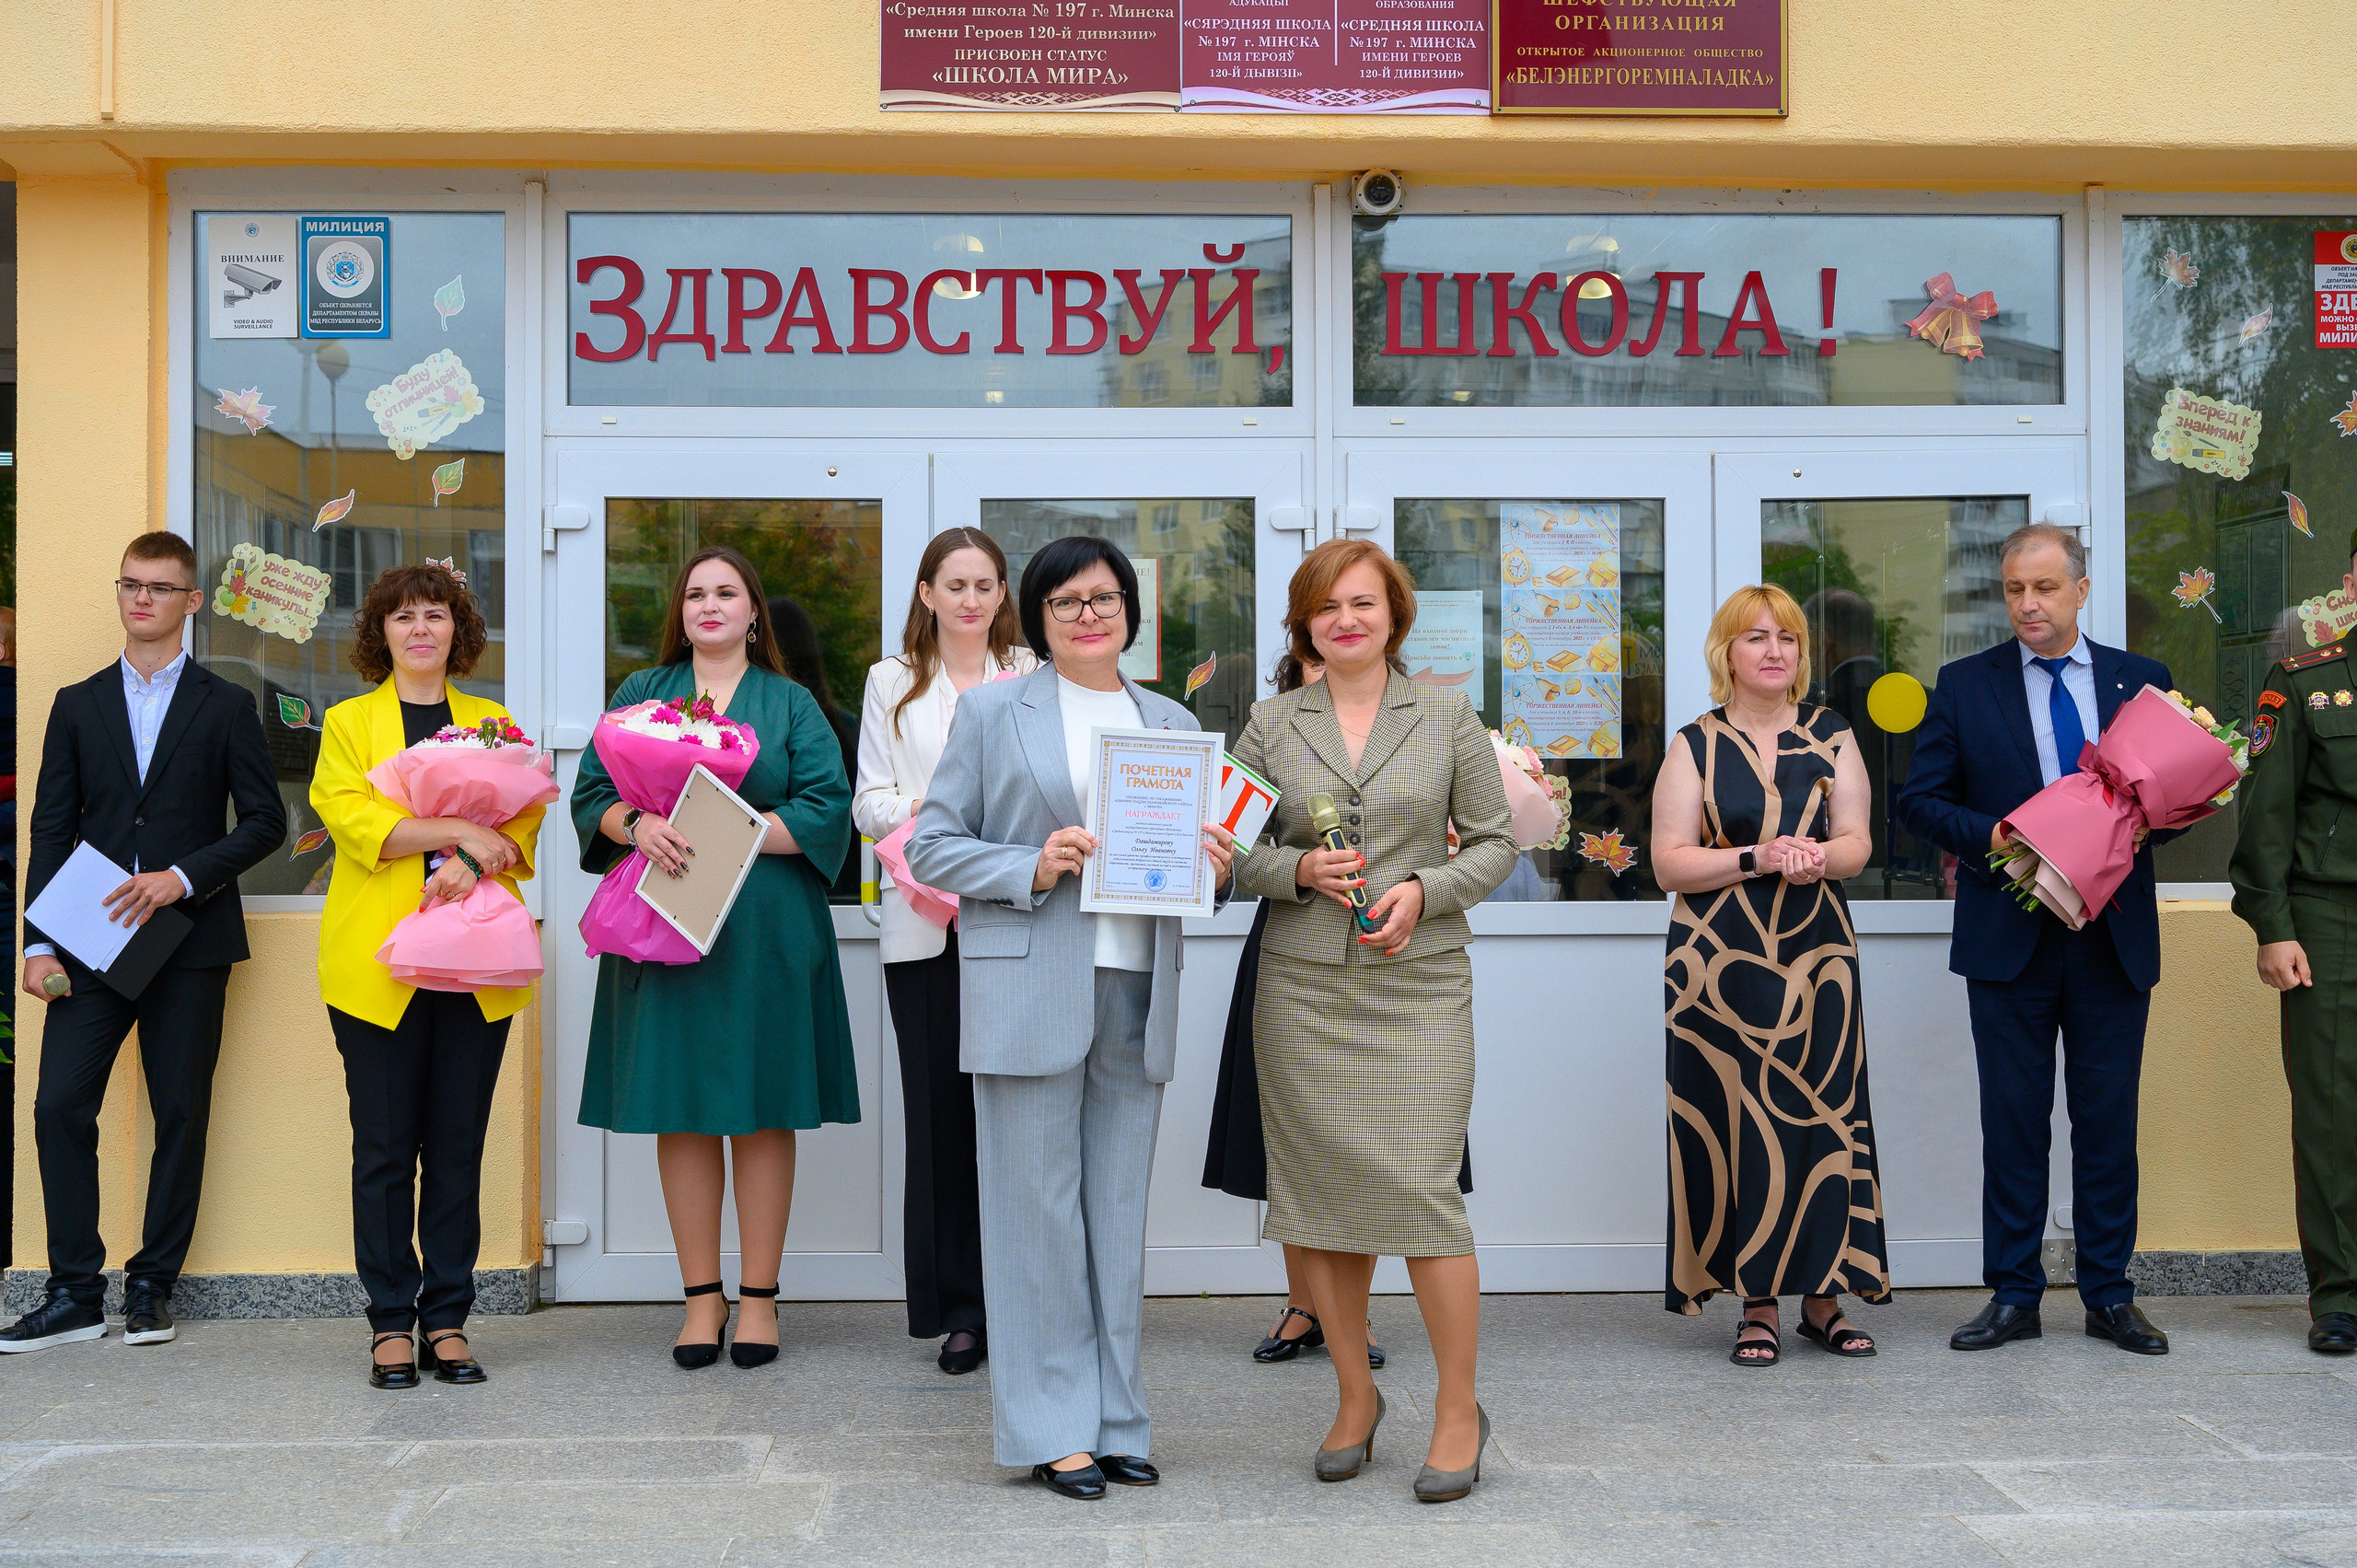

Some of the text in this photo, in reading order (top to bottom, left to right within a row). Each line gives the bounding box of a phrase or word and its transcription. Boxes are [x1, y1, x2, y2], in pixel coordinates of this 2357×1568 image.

[886, 2, 1174, 18] «Средняя школа № 197 г. Минска
[1376, 0, 1454, 9] ОБРАЗОВАНИЯ
[1183, 18, 1332, 32] «СЯРЭДНЯЯ ШКОЛА
[1341, 20, 1485, 32] «СРЕДНЯЯ ШКОЛА
[1555, 15, 1725, 33] ОРГАНИЗАЦИЯ
[904, 25, 1157, 41] имени Героев 120-й дивизии»
[1244, 39, 1254, 48] г.
[1259, 36, 1320, 48] МІНСКА
[1396, 39, 1406, 48] г.
[1410, 37, 1477, 48] МИНСКА
[955, 49, 1107, 62] ПРИСВОЕН СТАТУС
[1216, 50, 1295, 62] ІМЯ ГЕРОЯЎ
[1362, 52, 1462, 62] ИМЕНИ ГЕРОЕВ
[1516, 46, 1763, 58] ОТКРЫТОЕ АКЦИОНЕРНОЕ ОБЩЕСТВО
[932, 66, 1128, 85] «ШКОЛА МИРА»
[1210, 65, 1240, 78] 120-Й
[1360, 66, 1464, 80] 120-Й ДИВИЗИИ»
[1506, 67, 1774, 89] «БЕЛЭНЕРГОРЕМНАЛАДКА»
[306, 222, 384, 234] МИЛИЦИЯ
[575, 243, 1285, 375] ЗДРАВСТВУЙ,
[395, 368, 430, 393] Буду
[385, 366, 459, 418] отличницей!
[2178, 394, 2251, 427] Вперёд к
[2176, 416, 2246, 444] знаниям!
[262, 561, 322, 590] уже жду
[261, 576, 313, 601] осенние
[1120, 763, 1191, 778] ПОЧЕТНАЯ
[1126, 777, 1184, 790] ГРАМОТА
[1125, 810, 1182, 819] НАГРАЖДАЕТ
